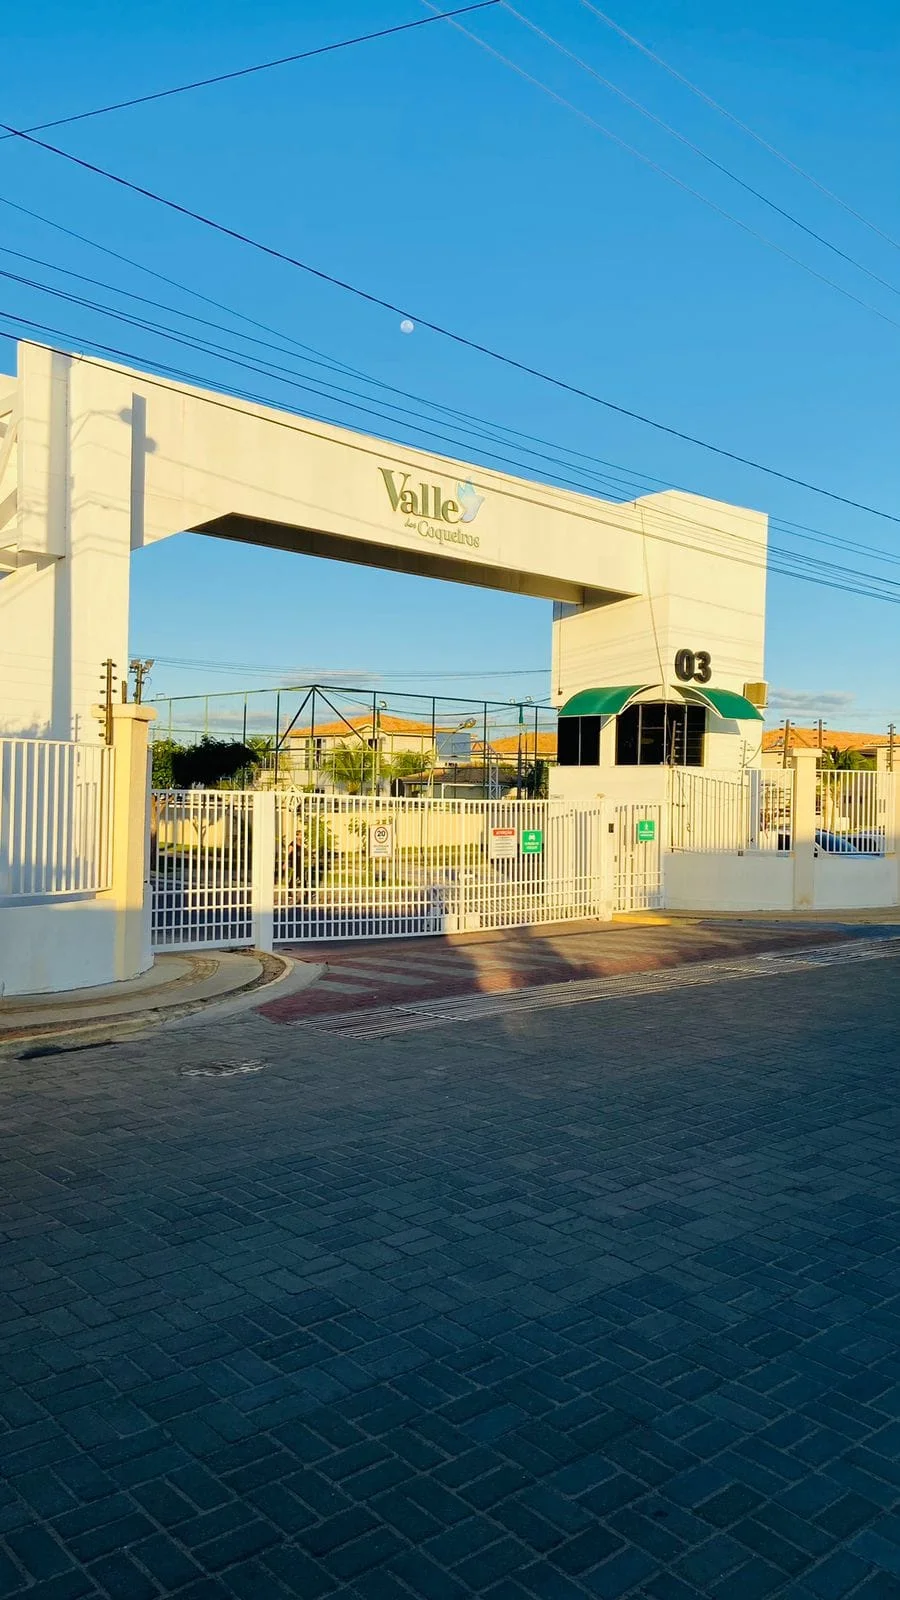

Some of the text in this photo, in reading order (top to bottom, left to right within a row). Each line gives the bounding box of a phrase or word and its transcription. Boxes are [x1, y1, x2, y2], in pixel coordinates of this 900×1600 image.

[378, 467, 460, 524] Valle
[417, 521, 480, 548] Coqueiros
[674, 649, 712, 684] 03
